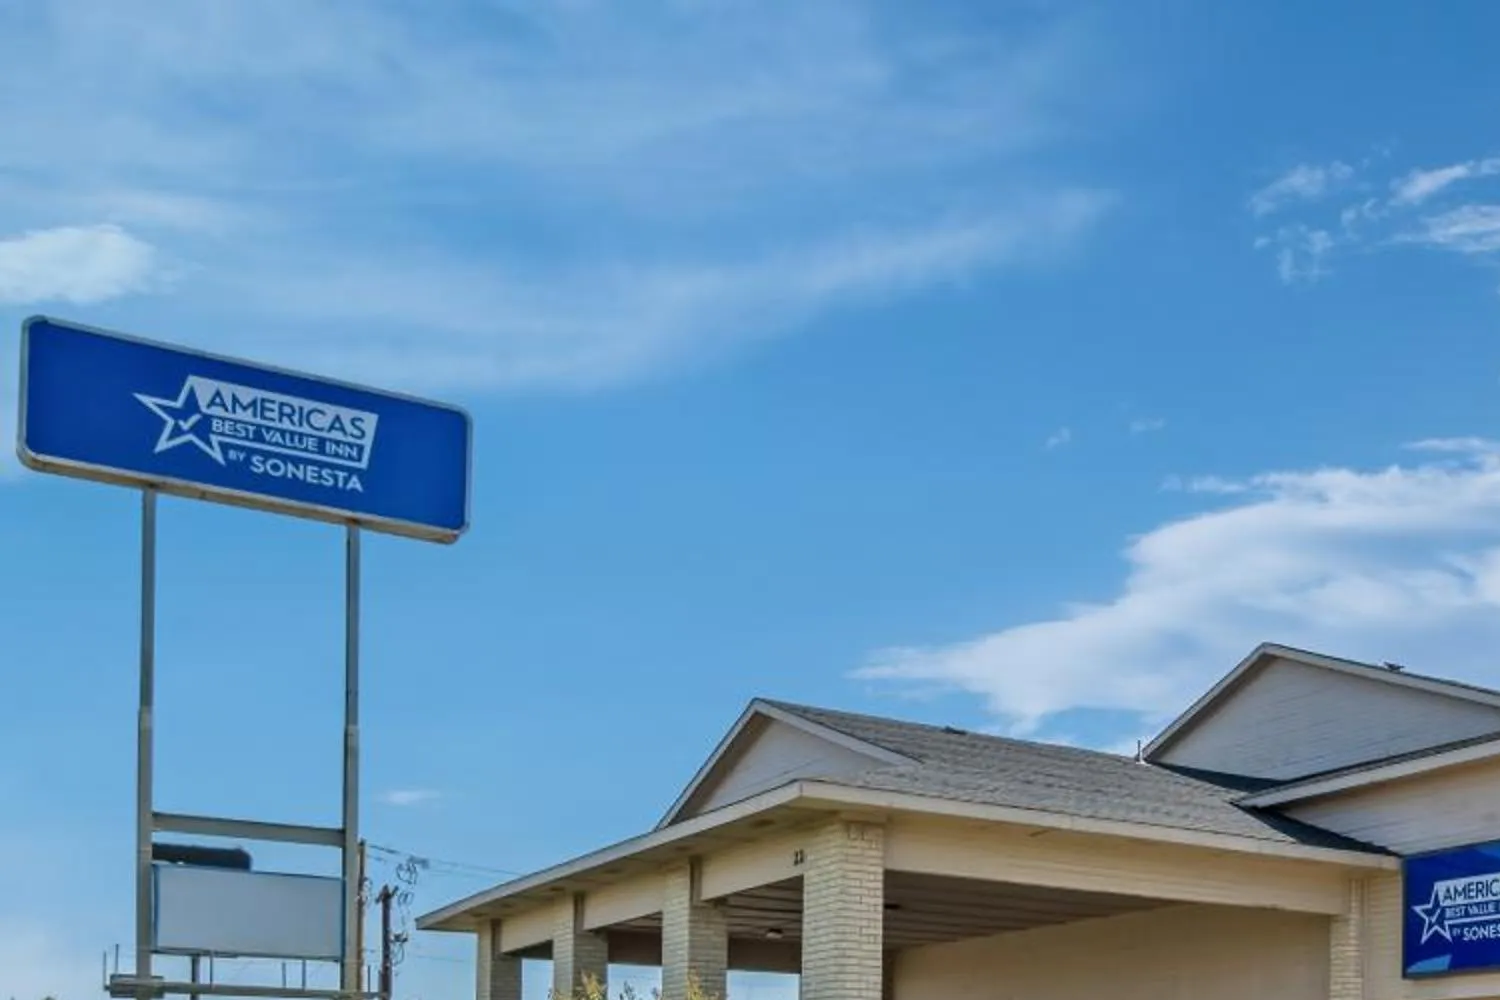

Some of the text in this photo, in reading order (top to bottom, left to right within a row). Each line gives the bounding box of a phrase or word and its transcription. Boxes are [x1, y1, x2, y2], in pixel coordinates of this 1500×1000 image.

[206, 388, 366, 440] AMERICAS
[211, 418, 358, 460] BEST VALUE INN
[228, 449, 364, 492] BY SONESTA
[1445, 905, 1465, 918] BEST
[1468, 902, 1497, 915] VALUE
